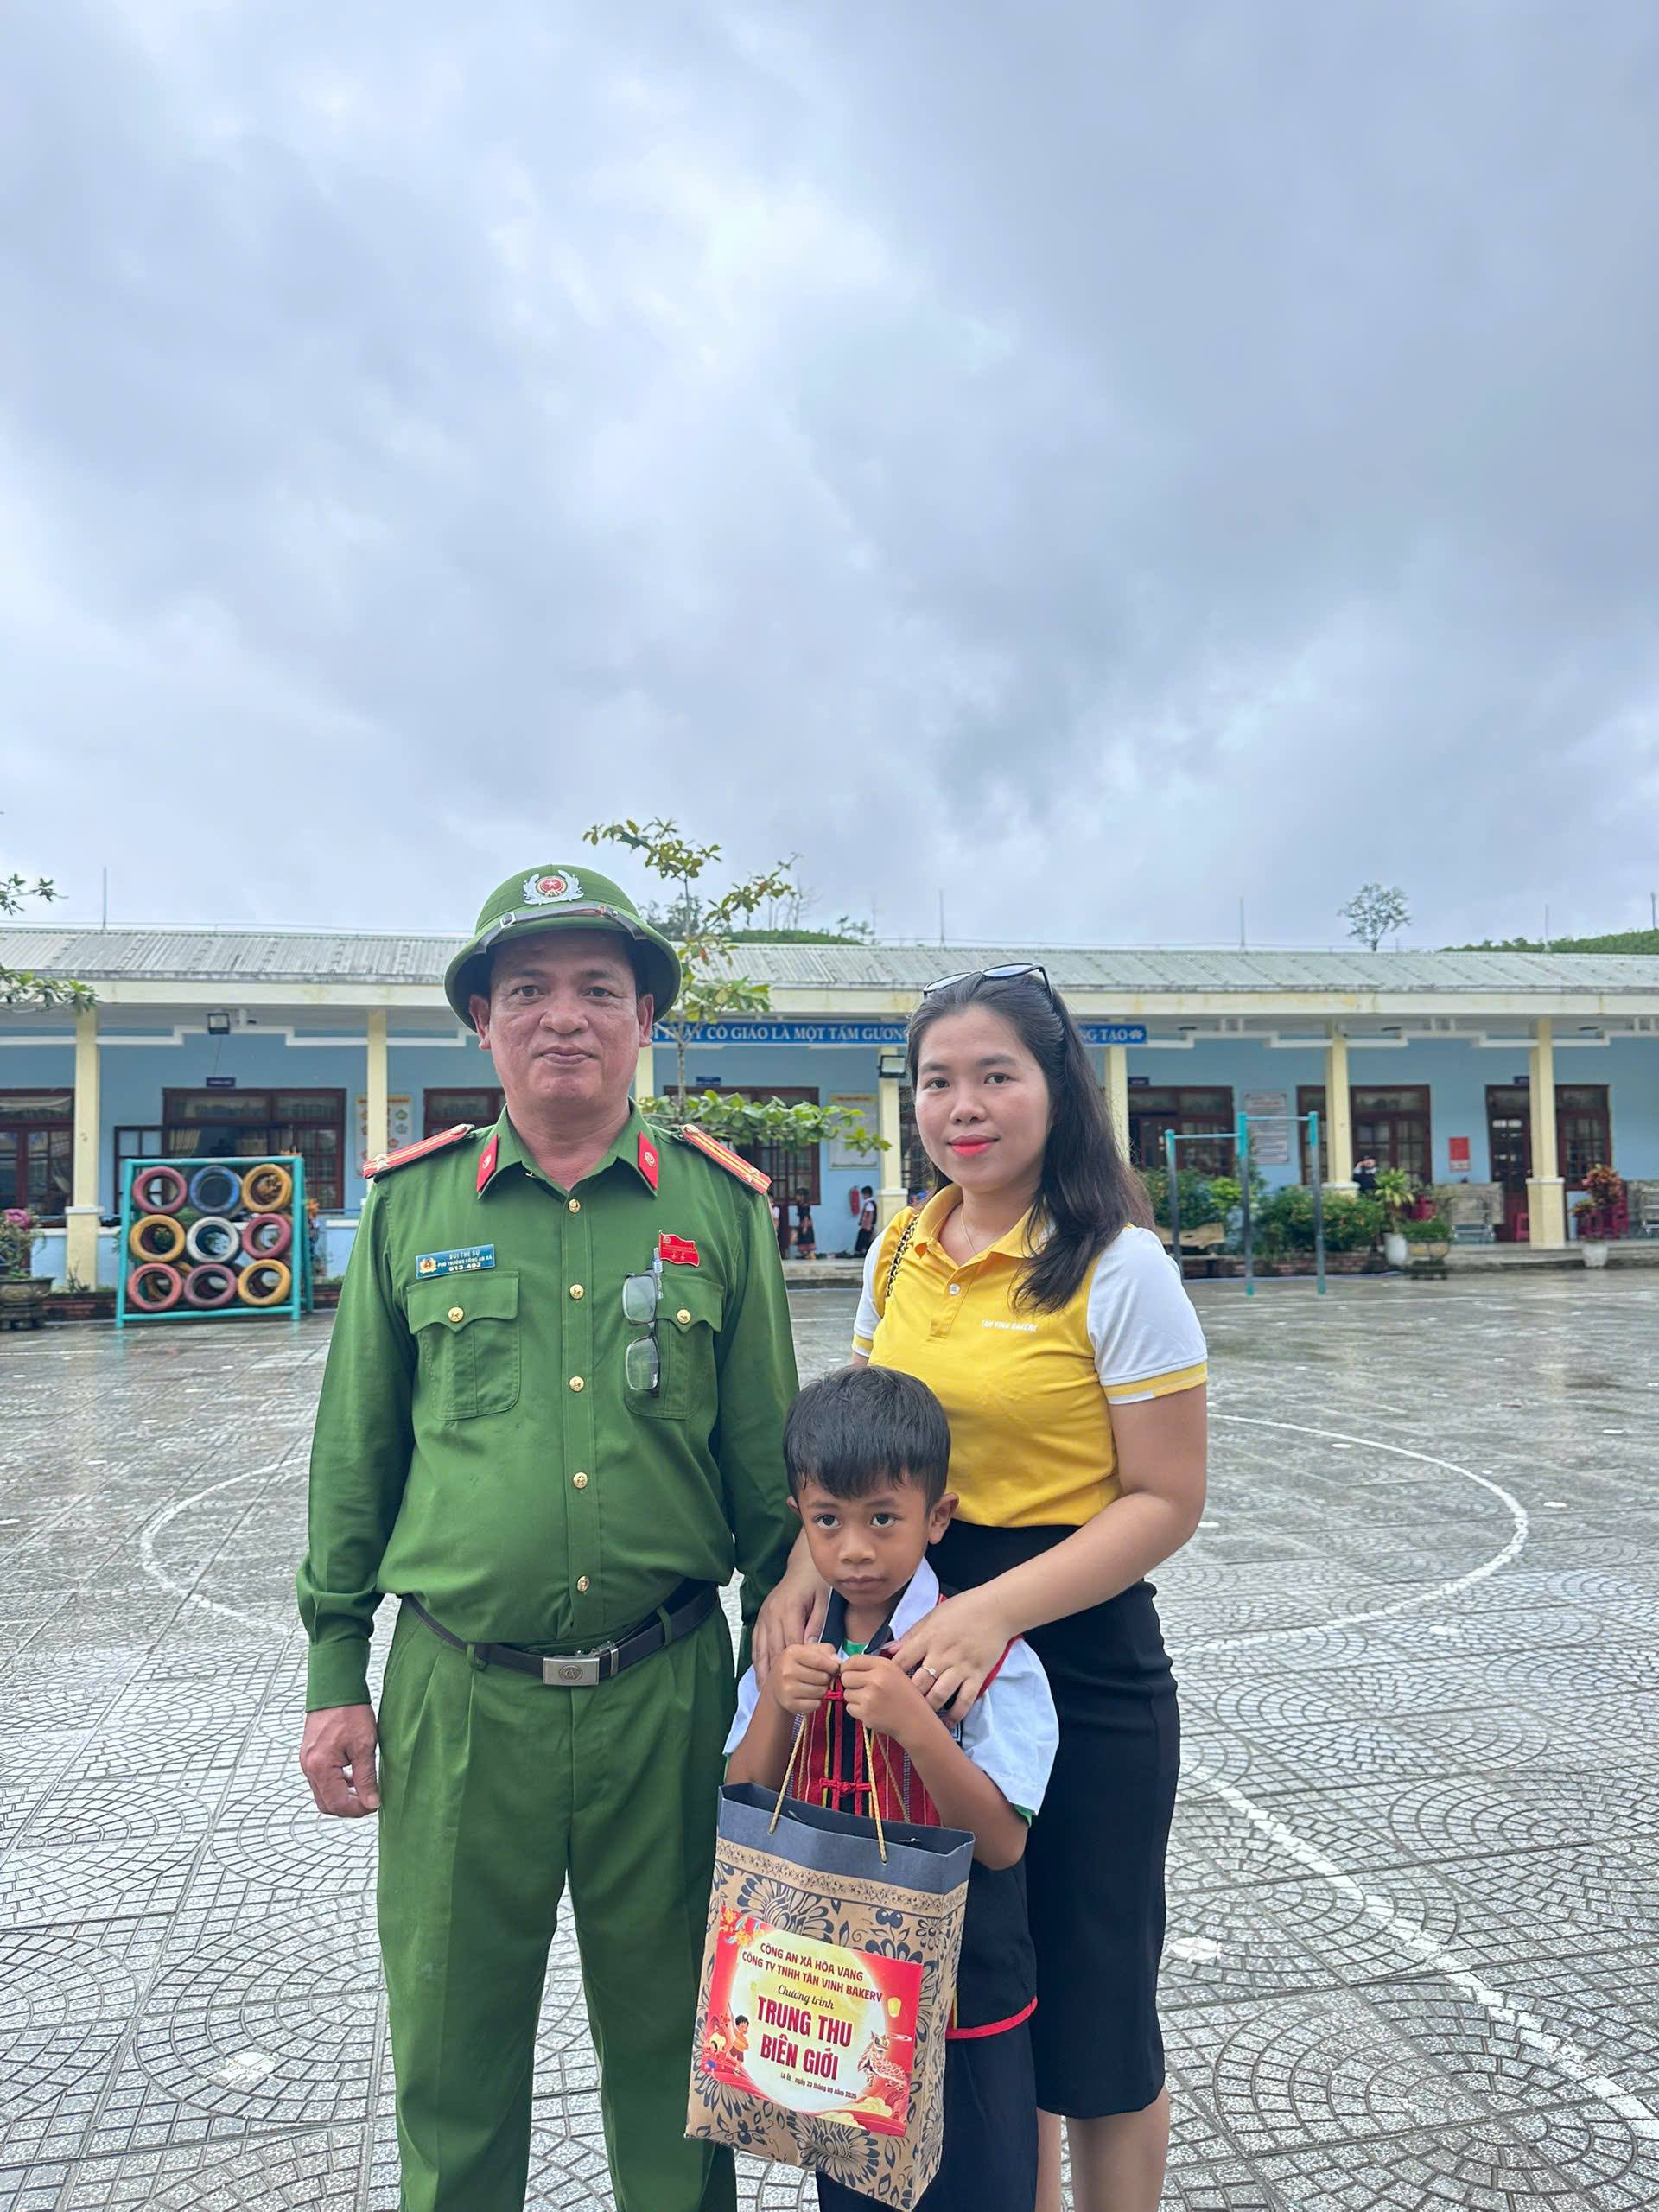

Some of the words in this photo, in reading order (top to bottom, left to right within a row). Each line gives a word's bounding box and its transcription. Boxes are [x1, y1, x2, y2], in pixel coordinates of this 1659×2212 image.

[706, 1025, 728, 1039] CÔ
[731, 1024, 768, 1039] GIÁO
[772, 1024, 790, 1039] LÀ
[794, 1025, 825, 1042] MỘT
[742, 1950, 763, 1968] CÔNG
[766, 1959, 775, 1972] TY
[777, 1964, 800, 1980] TNHH
[803, 1972, 819, 1986] TÂN
[822, 1978, 843, 1993] VINH
[846, 1985, 883, 2002] BAKERY
[760, 1942, 783, 1960] CÔNG
[785, 1950, 798, 1964] AN
[800, 1955, 812, 1968] XÃ
[815, 1960, 835, 1974] HÒA
[837, 1966, 863, 1981] VANG
[778, 1985, 810, 2005] Chương
[811, 1993, 835, 2010] trình
[757, 1995, 812, 2037] TRUNG
[818, 2014, 853, 2047] THU
[760, 2033, 798, 2069] BIÊN
[803, 2047, 839, 2081] GIỚI
